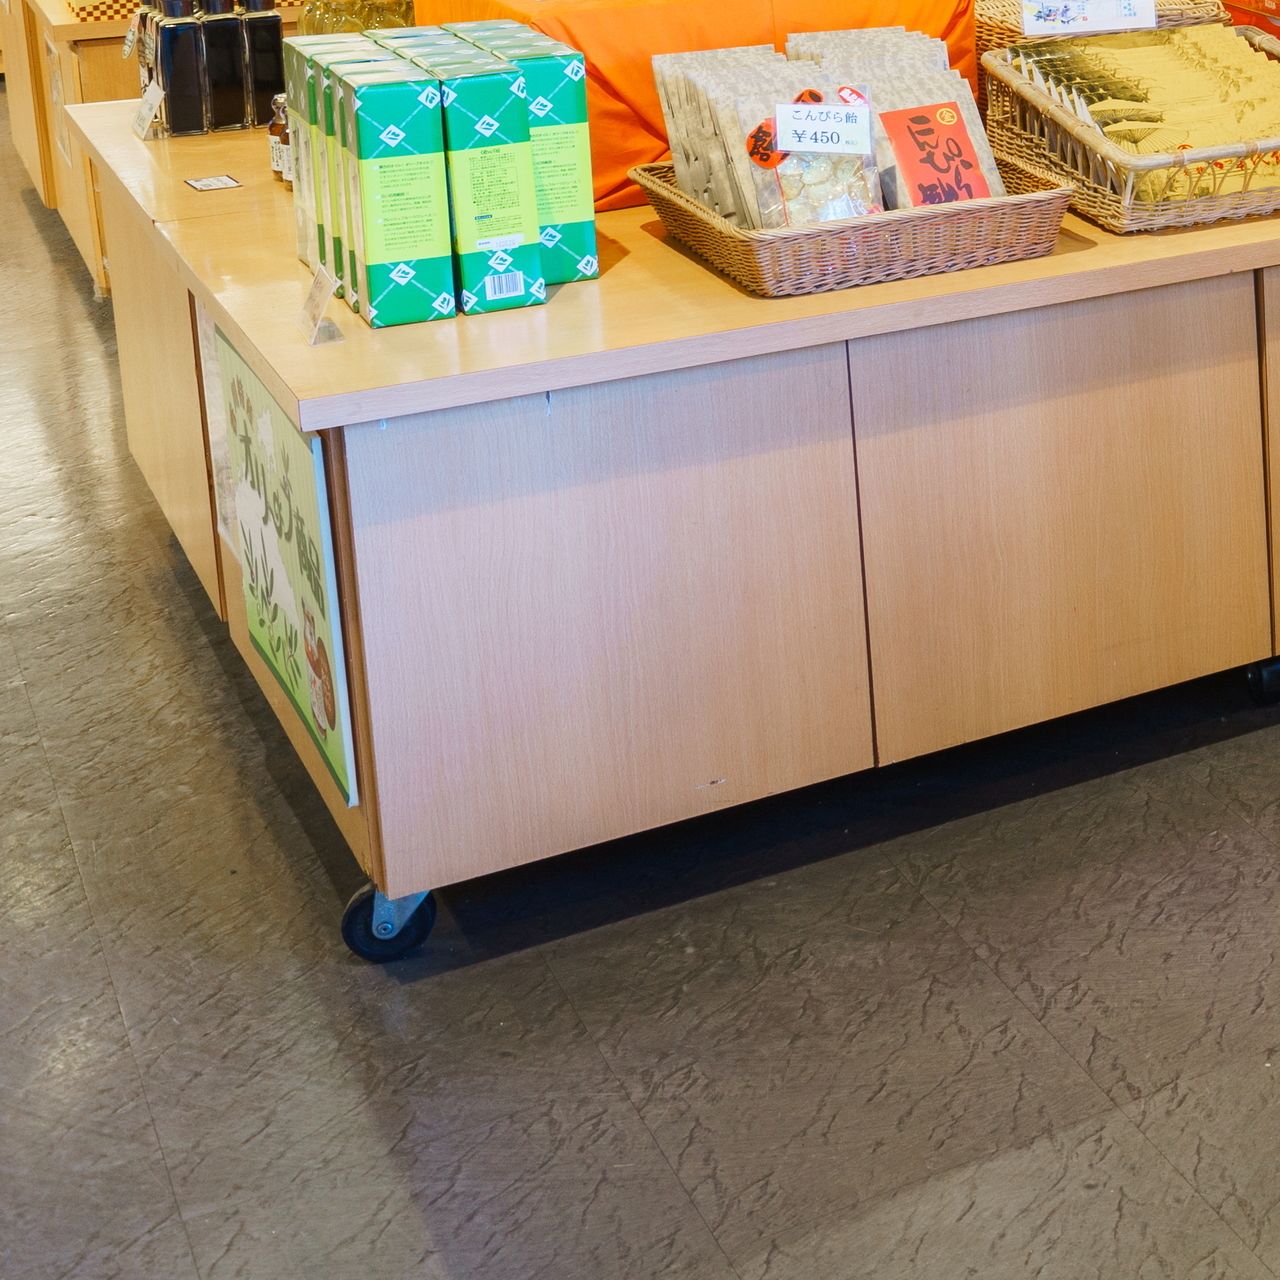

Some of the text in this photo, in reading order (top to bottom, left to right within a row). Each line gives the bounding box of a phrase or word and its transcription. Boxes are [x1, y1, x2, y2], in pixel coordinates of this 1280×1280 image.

[792, 109, 858, 125] こんぴら飴
[792, 129, 840, 145] ¥450
